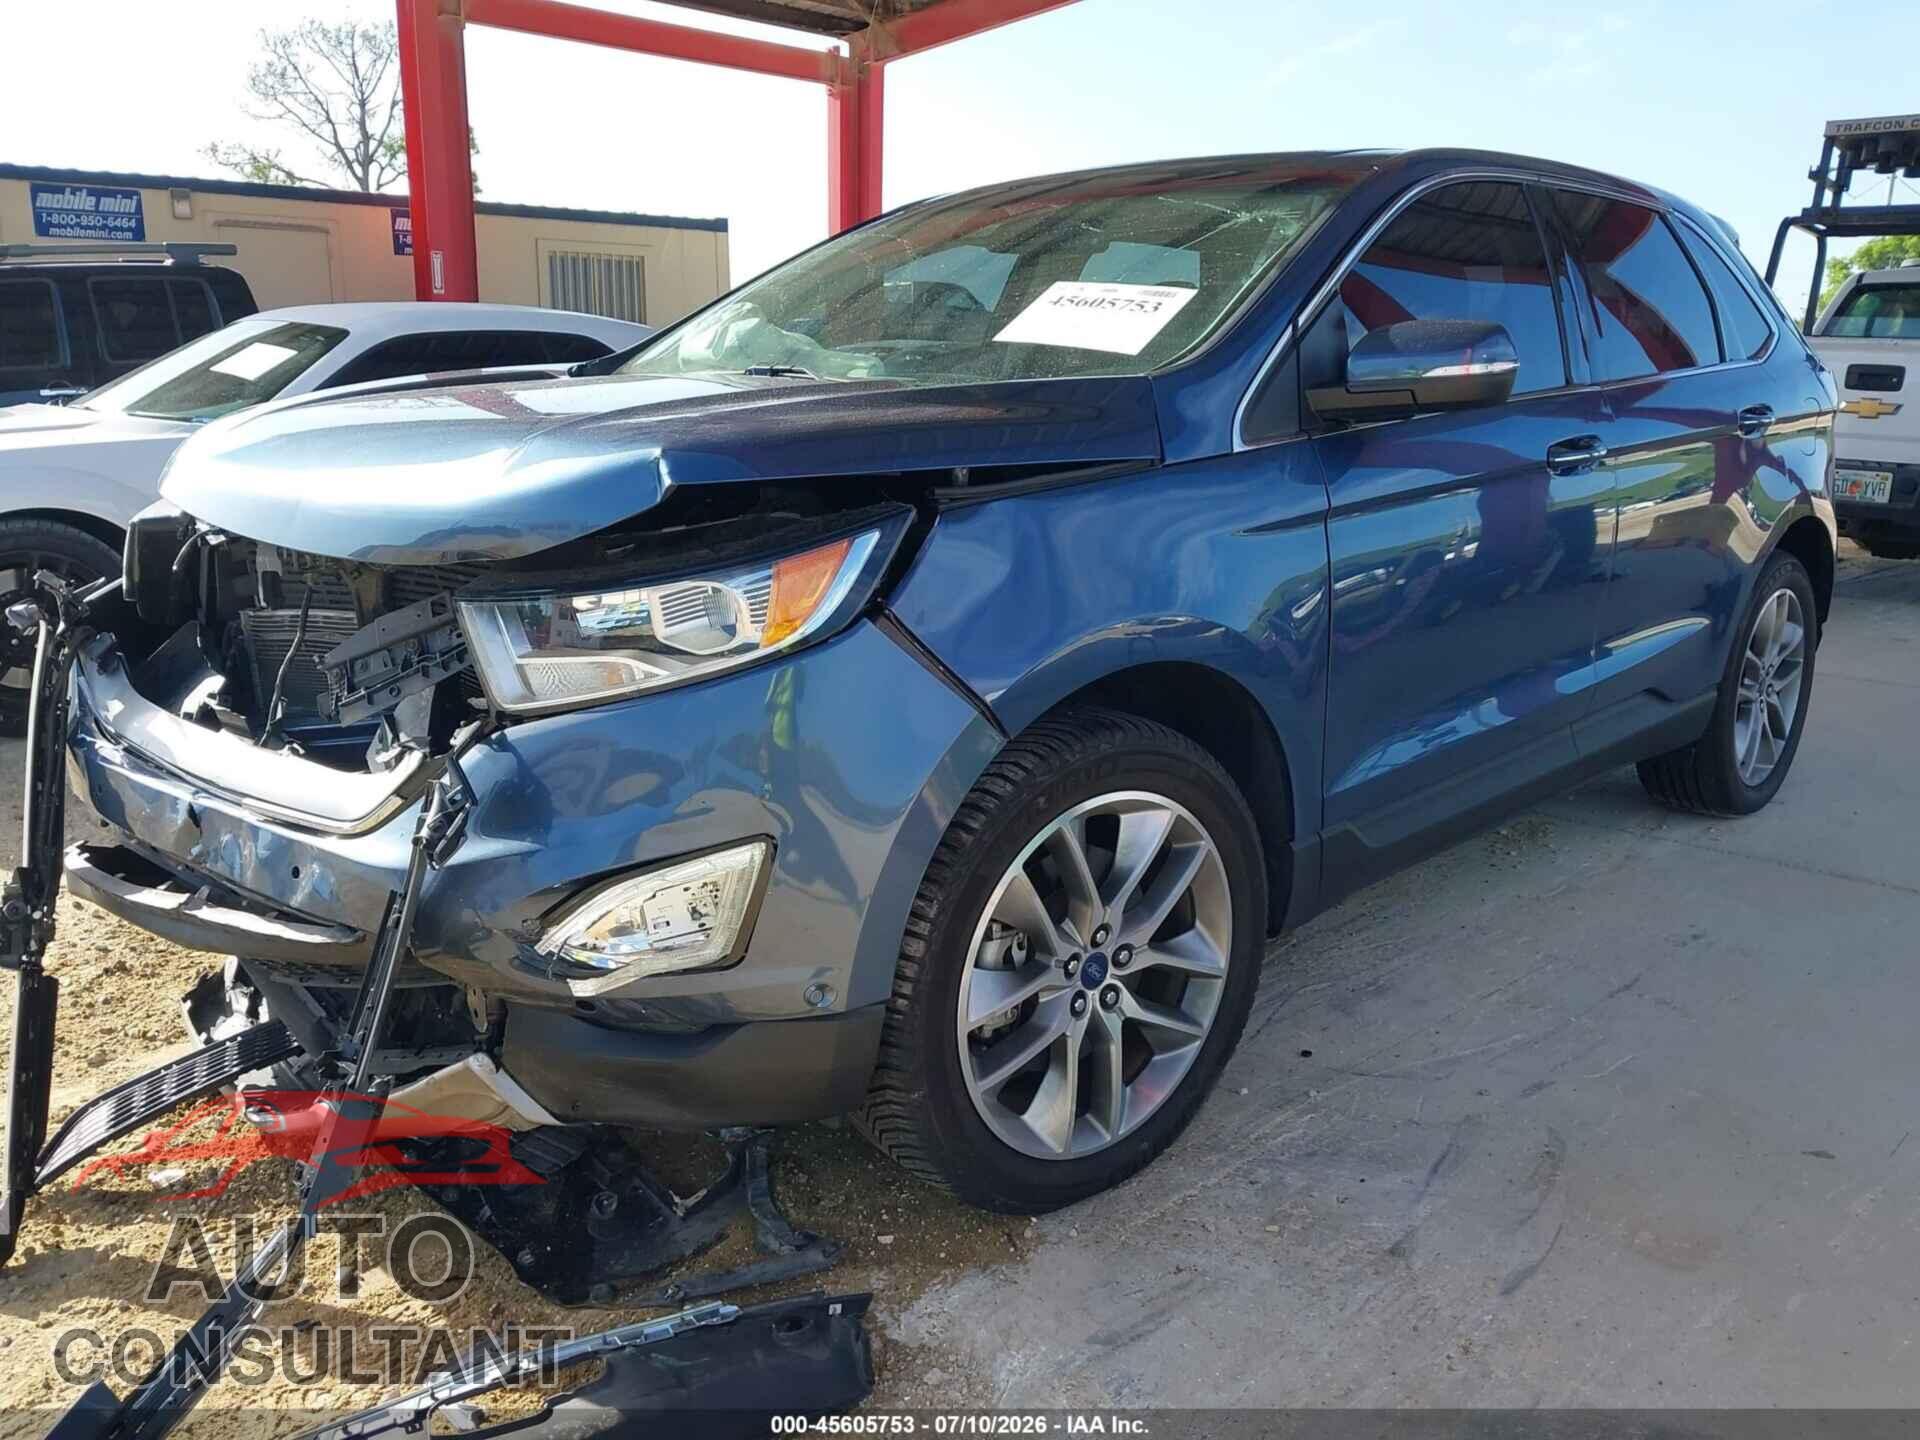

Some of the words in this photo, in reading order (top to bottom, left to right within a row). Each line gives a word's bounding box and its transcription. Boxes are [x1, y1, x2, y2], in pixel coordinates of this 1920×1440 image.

[1835, 119, 1905, 134] TRAFCON
[35, 187, 97, 211] mobile
[98, 194, 138, 213] mini
[48, 227, 133, 240] mobilemini.com
[1048, 295, 1163, 314] 45605753
